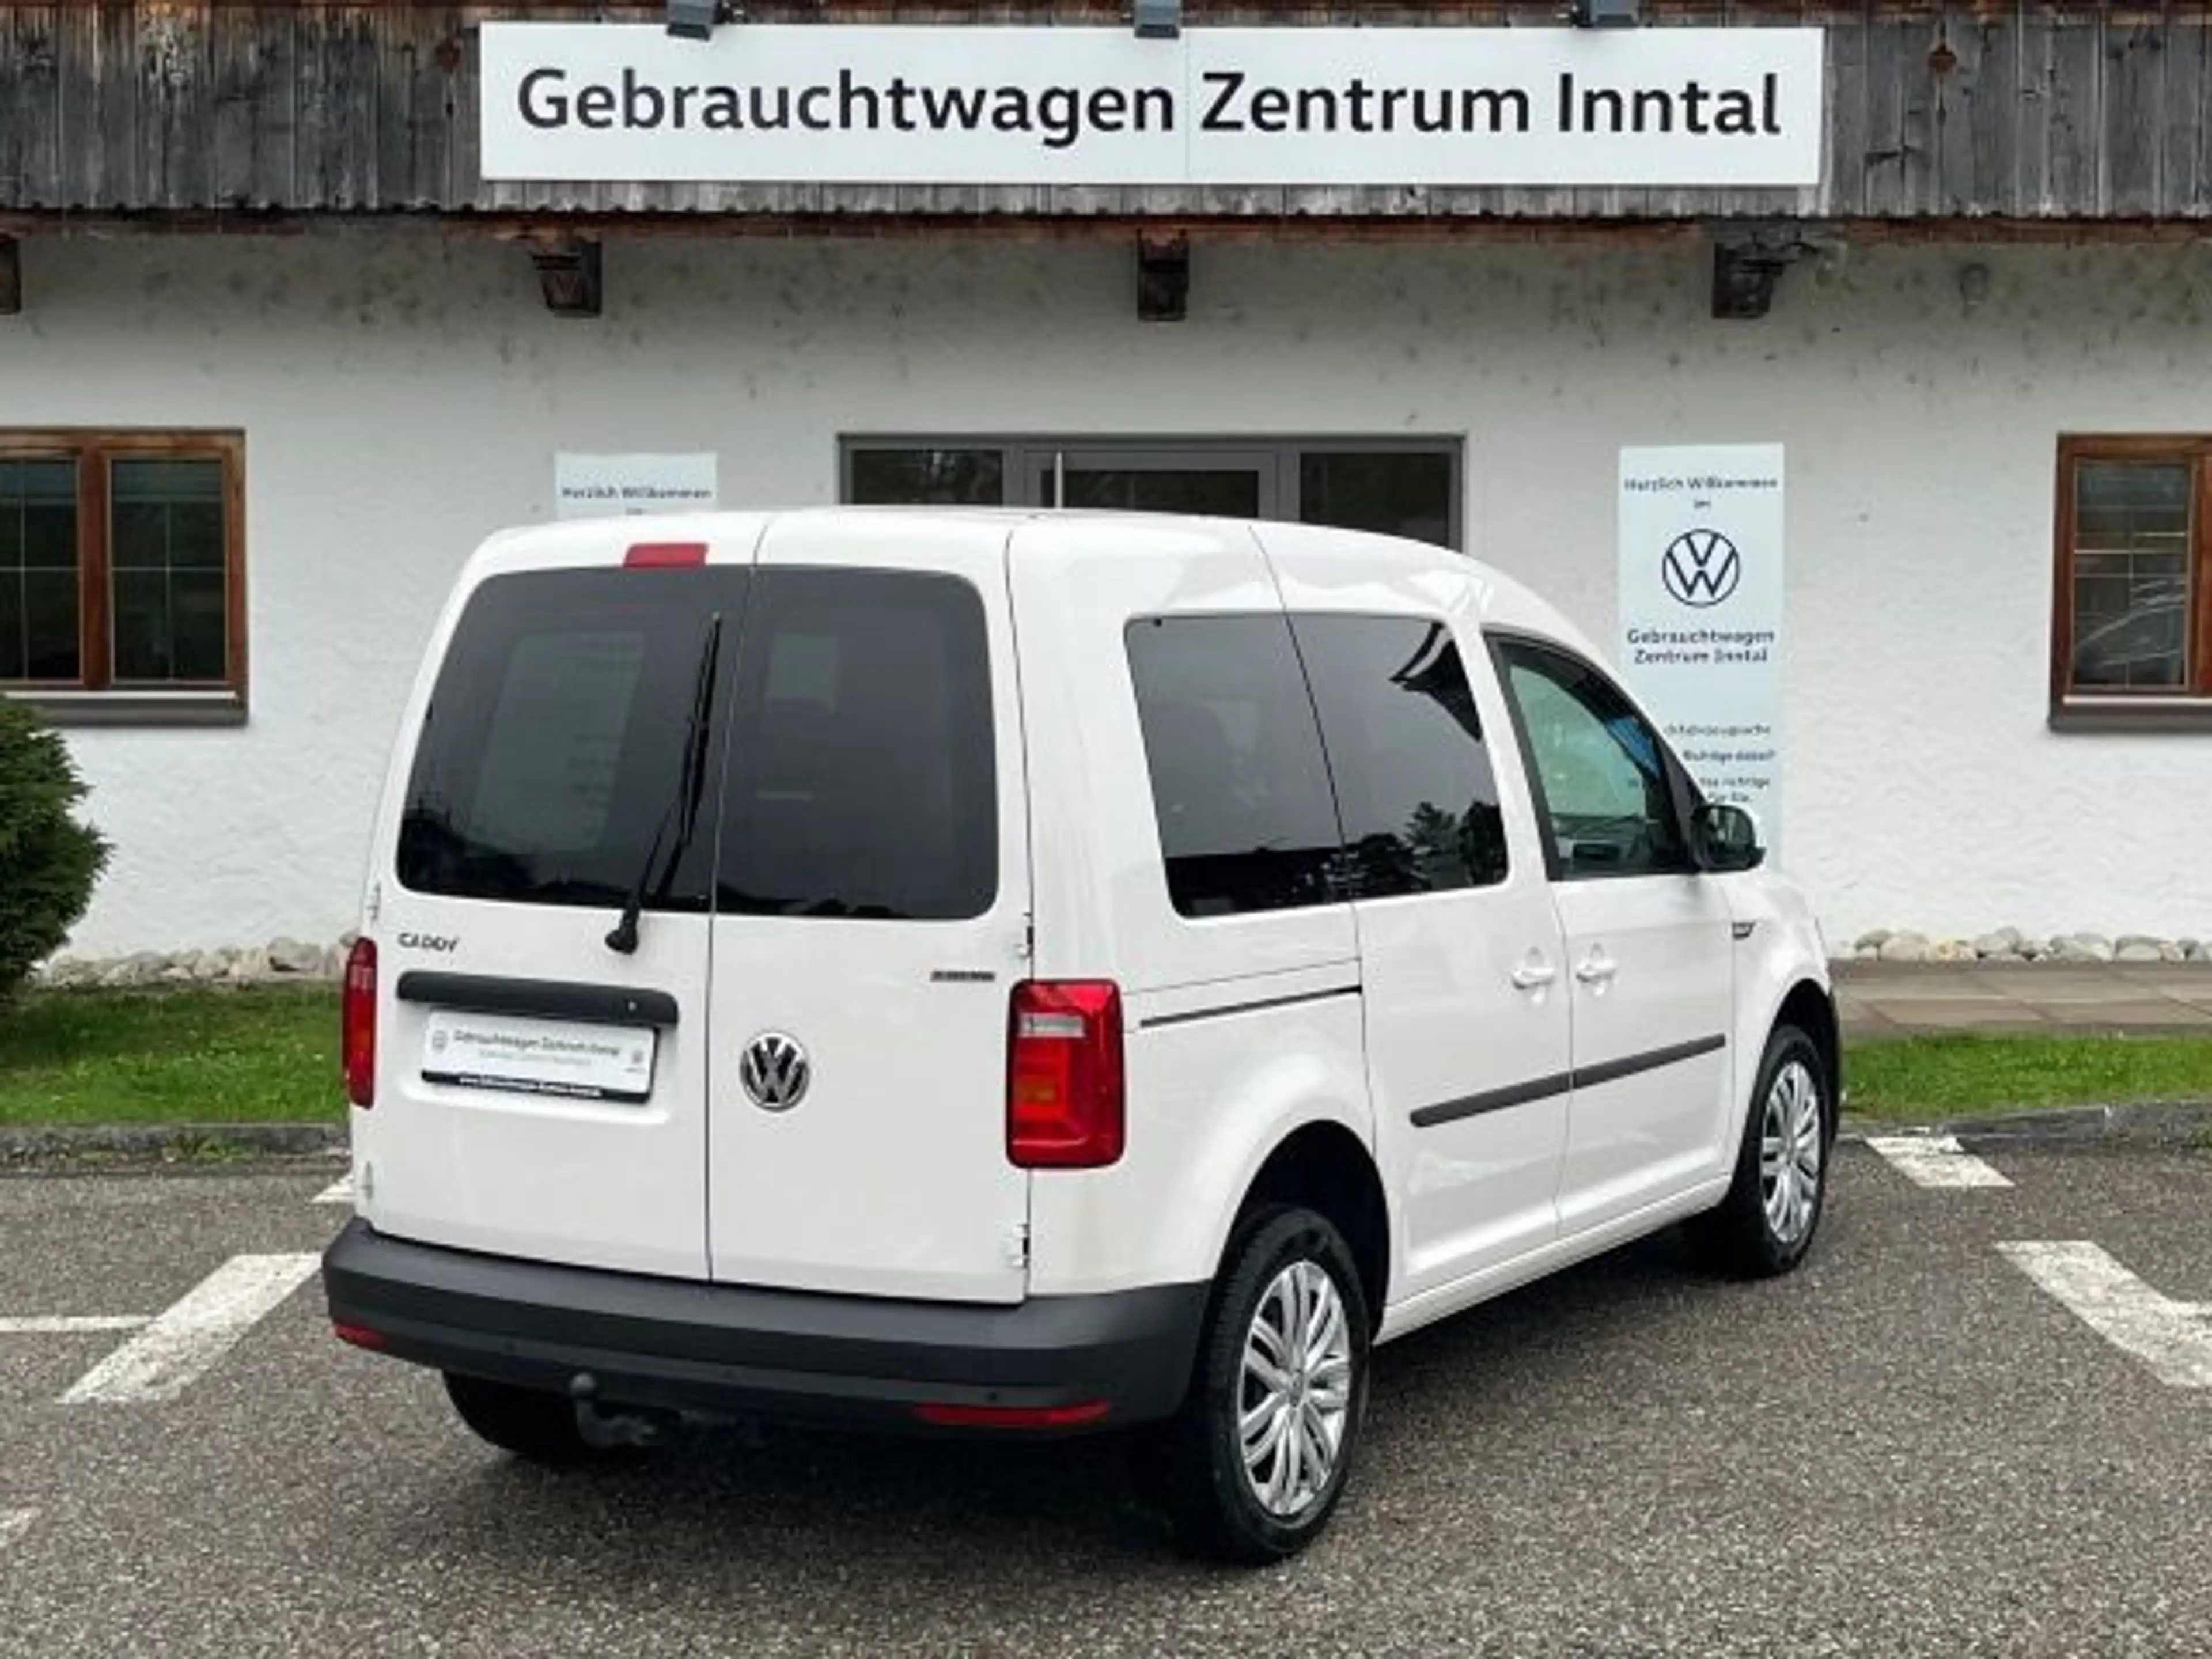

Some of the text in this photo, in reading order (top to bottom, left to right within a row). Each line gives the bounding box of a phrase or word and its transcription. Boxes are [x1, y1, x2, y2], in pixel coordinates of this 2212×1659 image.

[518, 67, 1781, 149] Gebrauchtwagen Zentrum Inntal
[1624, 476, 1778, 493] Herzlich Willkommen
[1626, 628, 1775, 646] Gebrauchtwagen
[1634, 648, 1768, 664] Zentrum Inntal
[397, 931, 460, 953] CADDY
